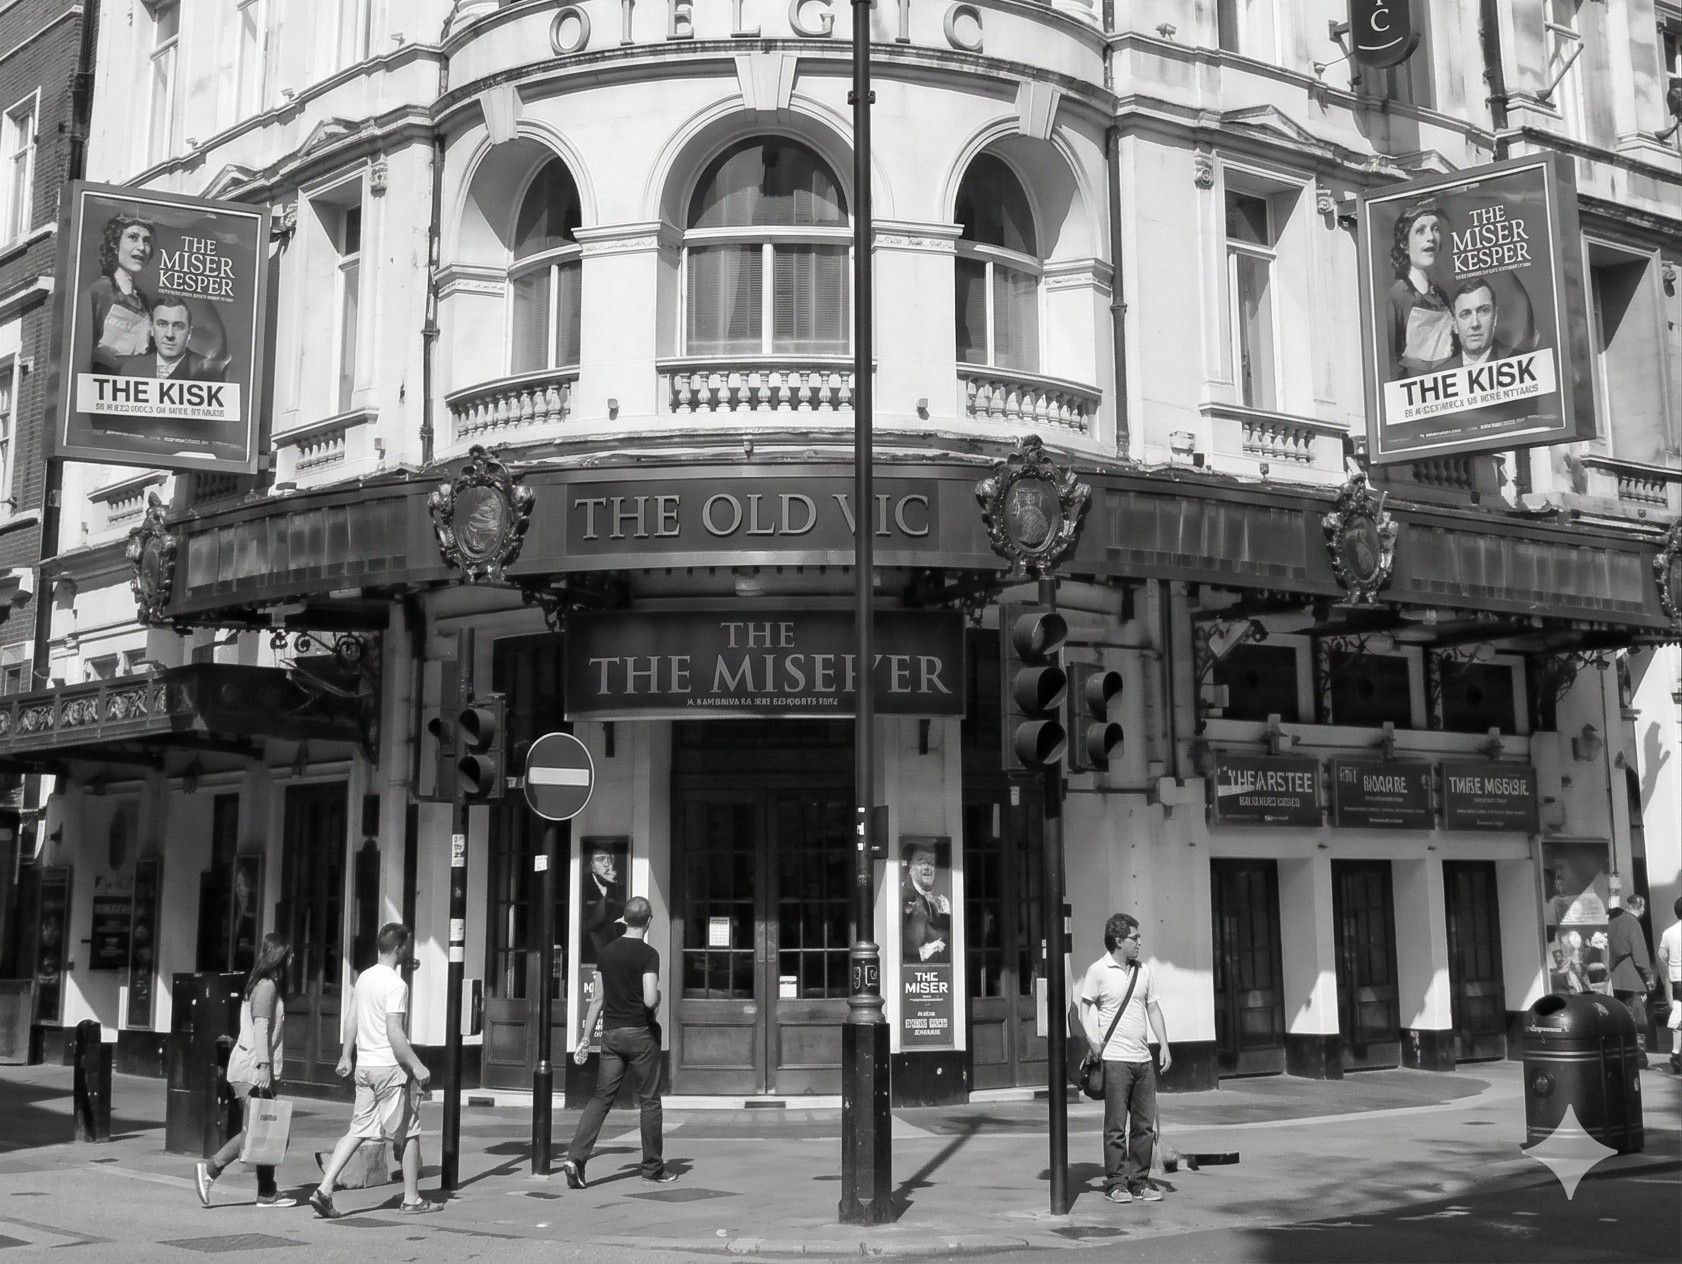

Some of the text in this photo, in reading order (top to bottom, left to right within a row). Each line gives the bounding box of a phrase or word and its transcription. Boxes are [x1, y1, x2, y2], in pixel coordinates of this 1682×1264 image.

[1469, 205, 1506, 226] THE
[181, 236, 217, 255] THE
[1451, 219, 1529, 253] MISER
[158, 248, 235, 278] MISER
[1452, 242, 1532, 273] KESPER
[158, 270, 235, 297] KESPER
[93, 378, 225, 408] THE KISK
[1400, 356, 1537, 406] THE KISK
[574, 494, 682, 540] THE
[702, 493, 818, 538] OLD
[720, 622, 795, 649] THE
[588, 655, 692, 696] THE
[905, 982, 949, 994] MISER
